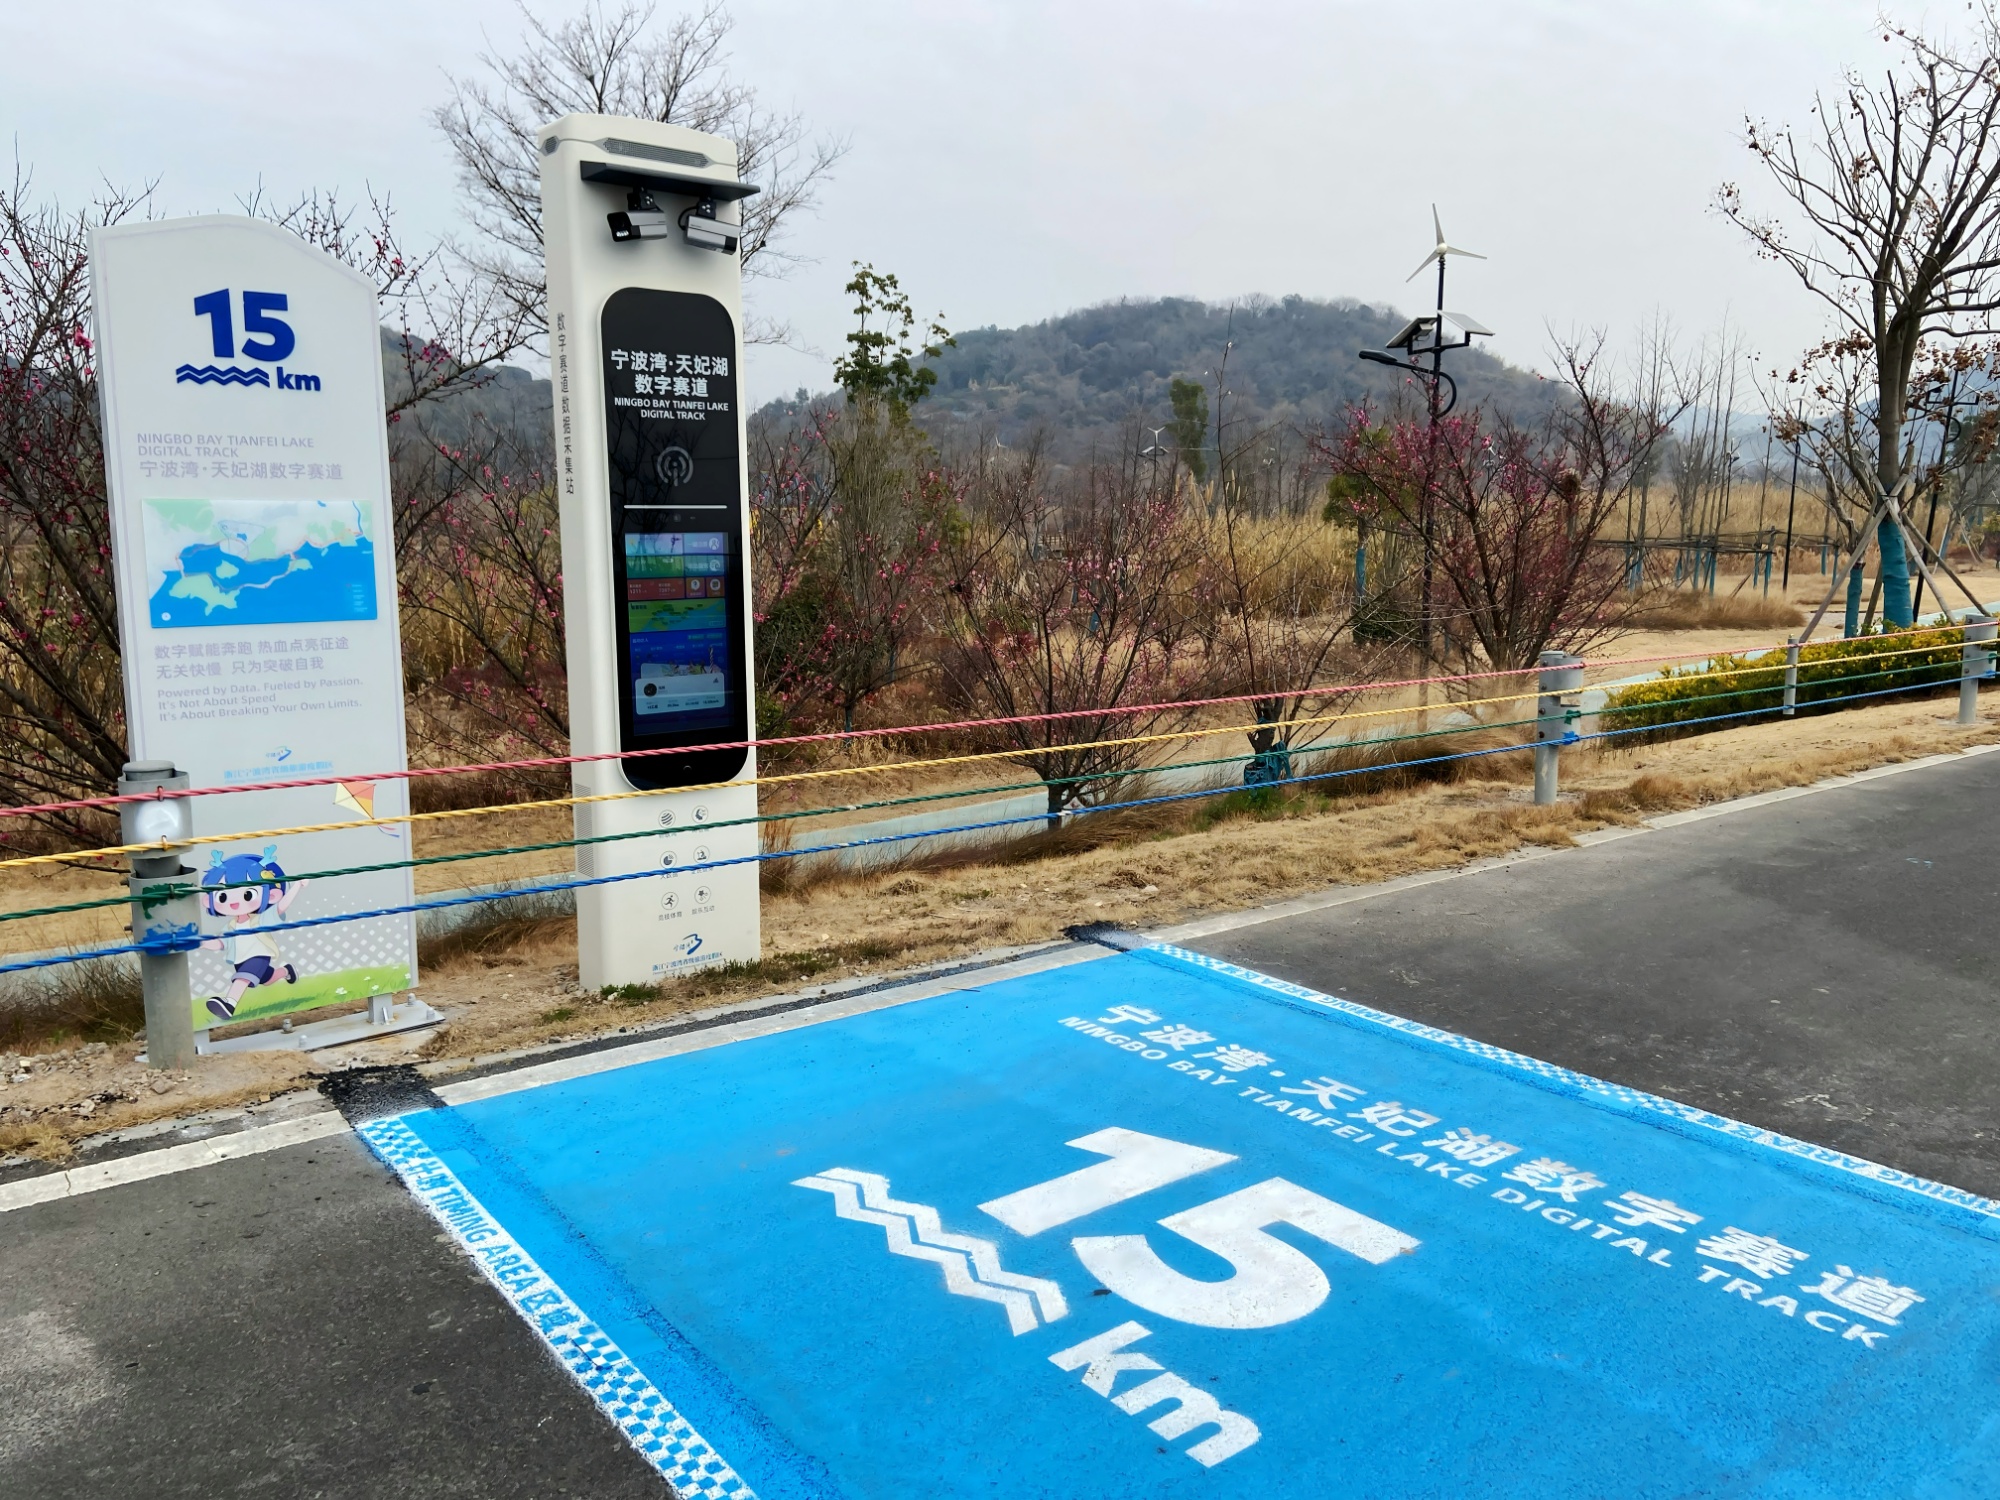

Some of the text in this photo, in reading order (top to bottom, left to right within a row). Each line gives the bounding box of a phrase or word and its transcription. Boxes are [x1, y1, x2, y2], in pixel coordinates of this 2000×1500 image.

[194, 288, 296, 362] 15
[611, 349, 729, 377] 宁波湾·天妃湖
[276, 366, 321, 391] km
[635, 374, 709, 397] 数字赛道
[557, 312, 574, 495] 数字赛道数据采集站
[614, 397, 729, 411] NINGBO BAY TIANFEI LAKE
[641, 409, 706, 420] DIGITAL TRACK
[137, 433, 315, 448] NINGBO BAY TIANFEI LAKE
[138, 445, 239, 458] DIGITAL TRACK
[139, 460, 343, 480] 宁波湾·天妃湖数字赛道
[155, 636, 349, 660] 数字赋能奔跑 热血点亮征途
[156, 656, 325, 679] 无关快慢 只为突破自我
[158, 676, 364, 698] Powered by Data. Fueled by Passion.
[179, 699, 200, 709] Not
[203, 696, 238, 707] About
[241, 693, 277, 705] Speed
[180, 709, 216, 720] About
[219, 705, 269, 718] Breaking
[272, 702, 298, 713] Your
[300, 701, 325, 711] Own
[1261, 977, 1311, 998] AREA
[1320, 994, 1396, 1025] TIMING
[1772, 1135, 1870, 1170] AREA
[1098, 1004, 1926, 1326] 宁波湾·天妃湖数字赛道
[1057, 1015, 1890, 1349] NINGBO BAY TIANFEI LAKE DIGITAL TRACK
[977, 1126, 1422, 1329] 15
[431, 1187, 498, 1243] TIMING
[478, 1244, 540, 1294] AREA
[1048, 1320, 1261, 1468] km
